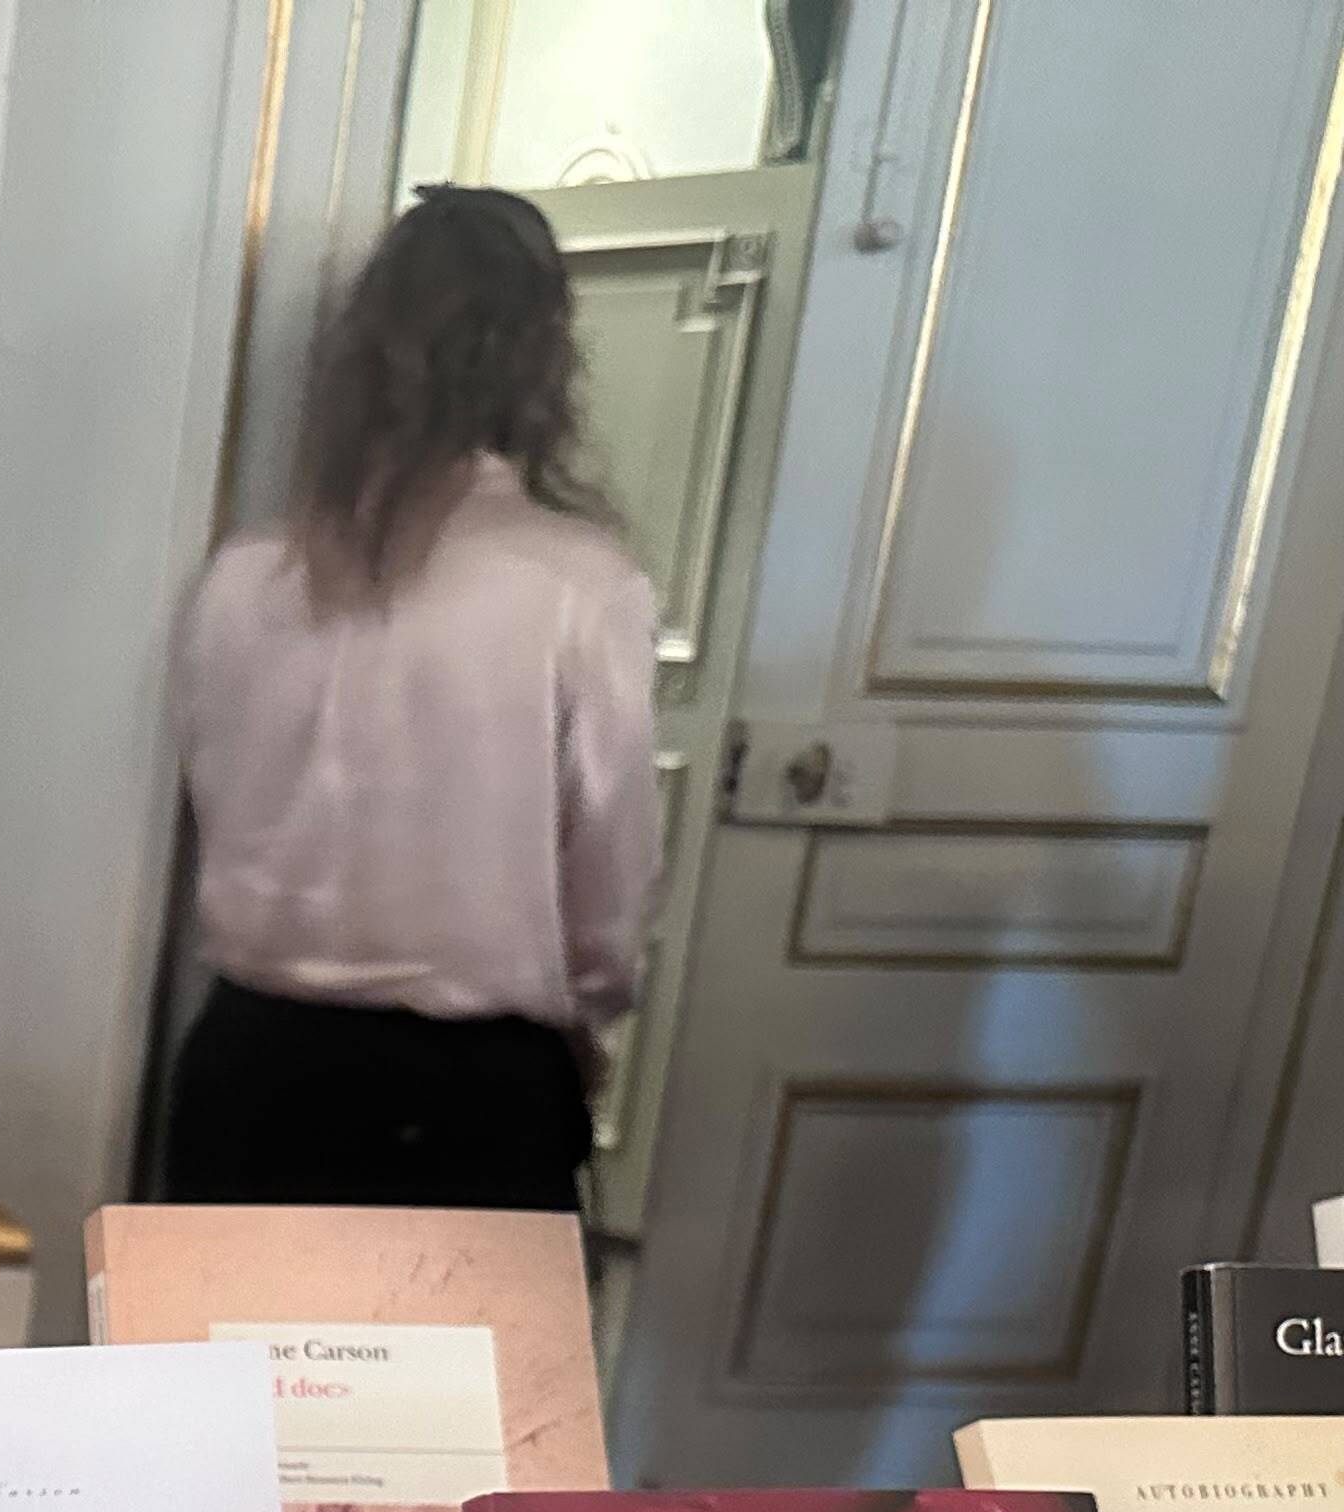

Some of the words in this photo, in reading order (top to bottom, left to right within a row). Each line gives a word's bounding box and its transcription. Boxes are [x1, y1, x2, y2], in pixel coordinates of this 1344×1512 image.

[1276, 1317, 1343, 1356] Gla
[303, 1339, 389, 1362] Carson
[1136, 1482, 1329, 1501] AUTOBIOGRAPHY
